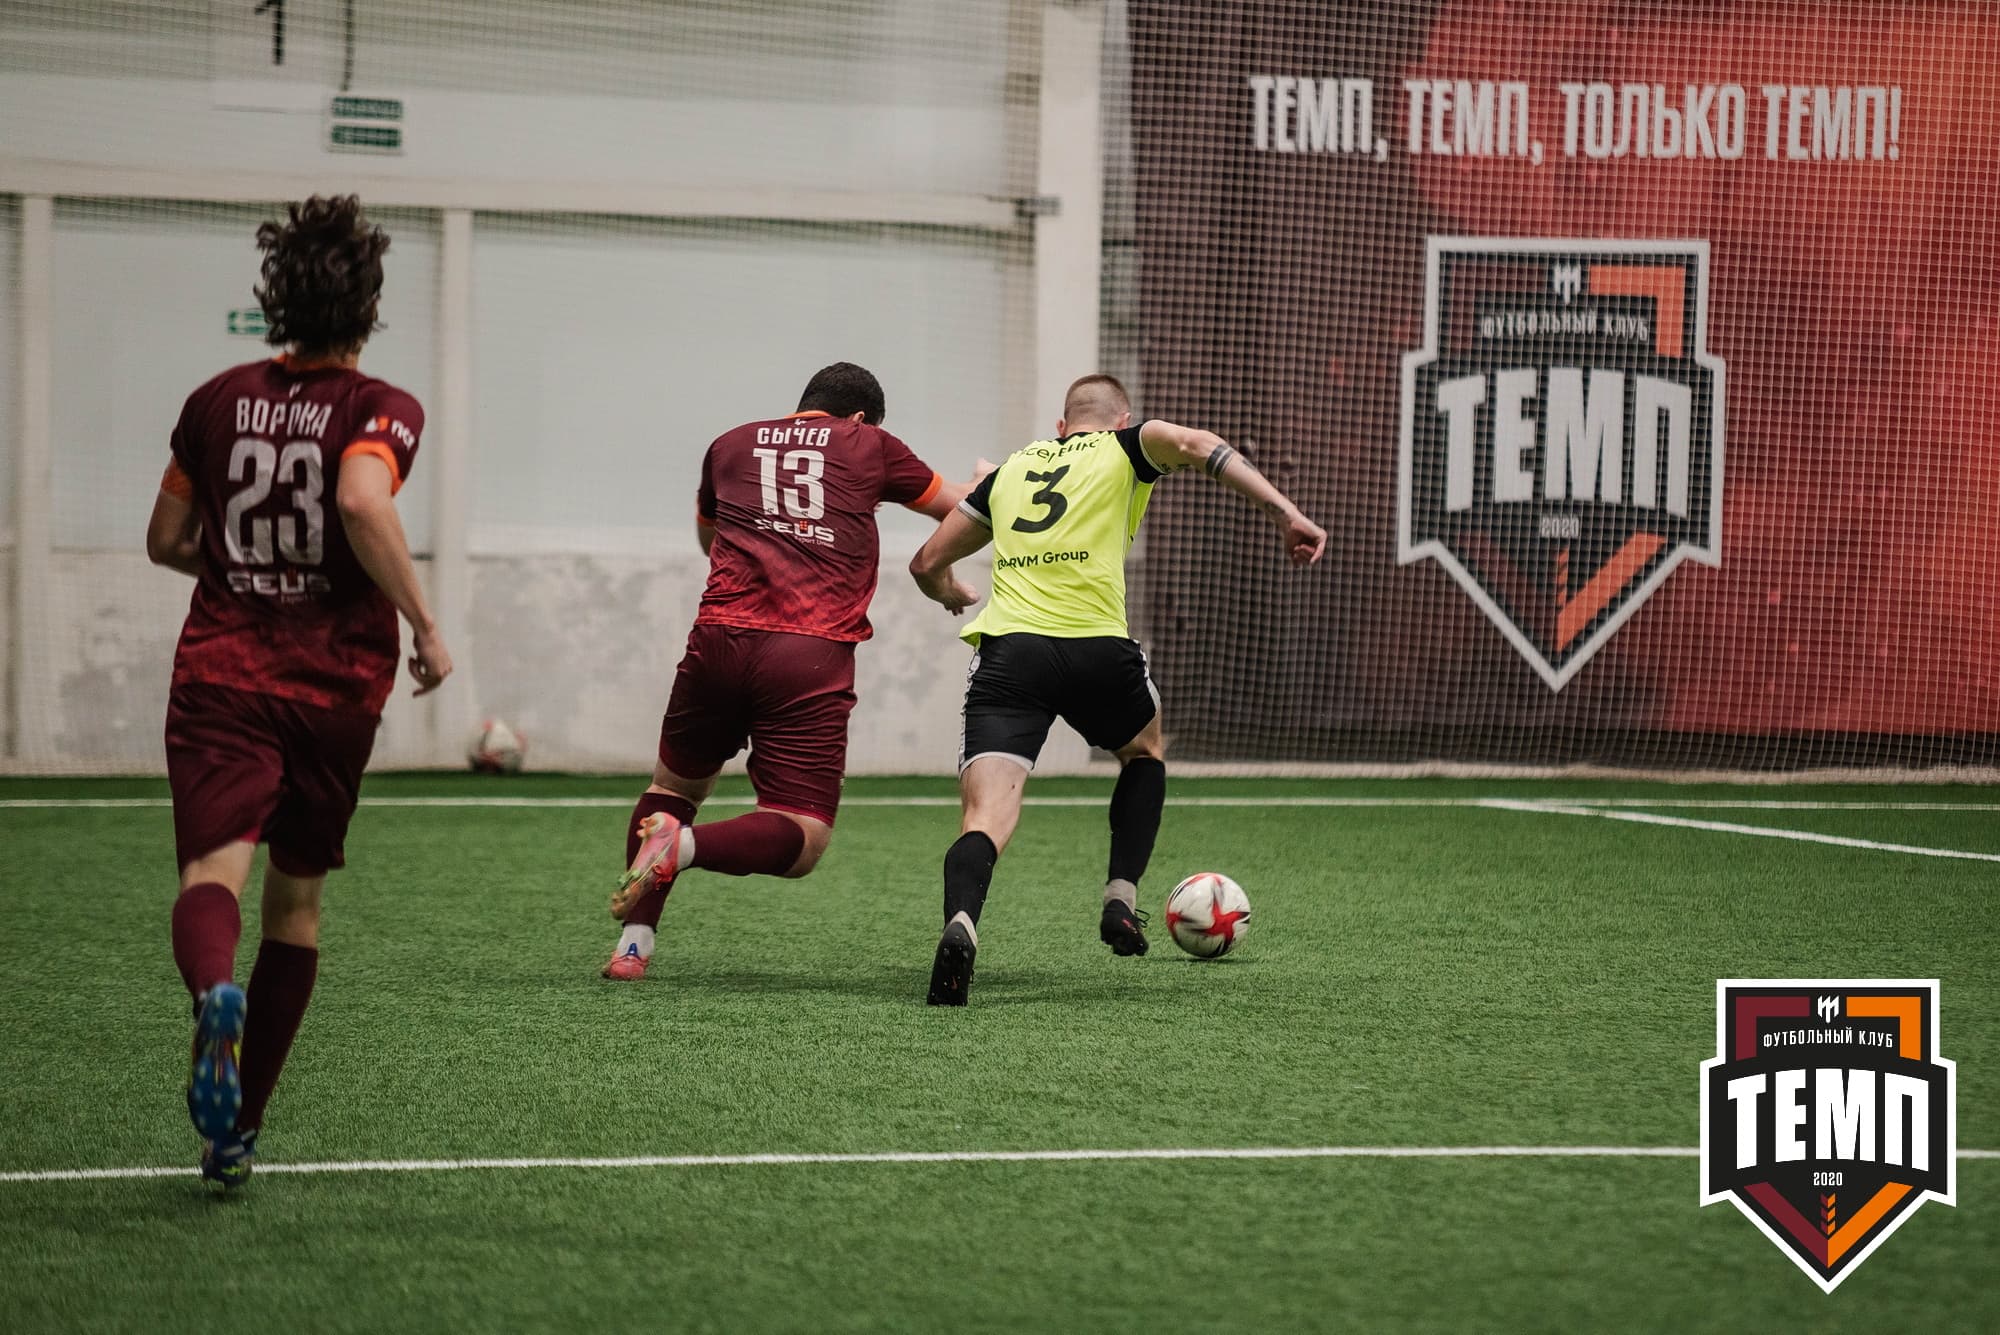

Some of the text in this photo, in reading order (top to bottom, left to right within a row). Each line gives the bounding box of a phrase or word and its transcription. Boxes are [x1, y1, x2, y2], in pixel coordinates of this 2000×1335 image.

[1249, 75, 1902, 166] ТЕМП, ТЕМП, ТОЛЬКО ТЕМП!
[1482, 309, 1649, 342] ФУТБОЛЬНЫЙ КЛУБ
[756, 426, 832, 448] СЫЧЕВ
[1436, 366, 1692, 519] ТЕМП
[224, 437, 325, 566] 23
[752, 447, 826, 520] 13
[1010, 463, 1072, 534] 3
[753, 519, 835, 543] SEUS
[1540, 514, 1580, 540] 2020
[1042, 550, 1090, 565] Group
